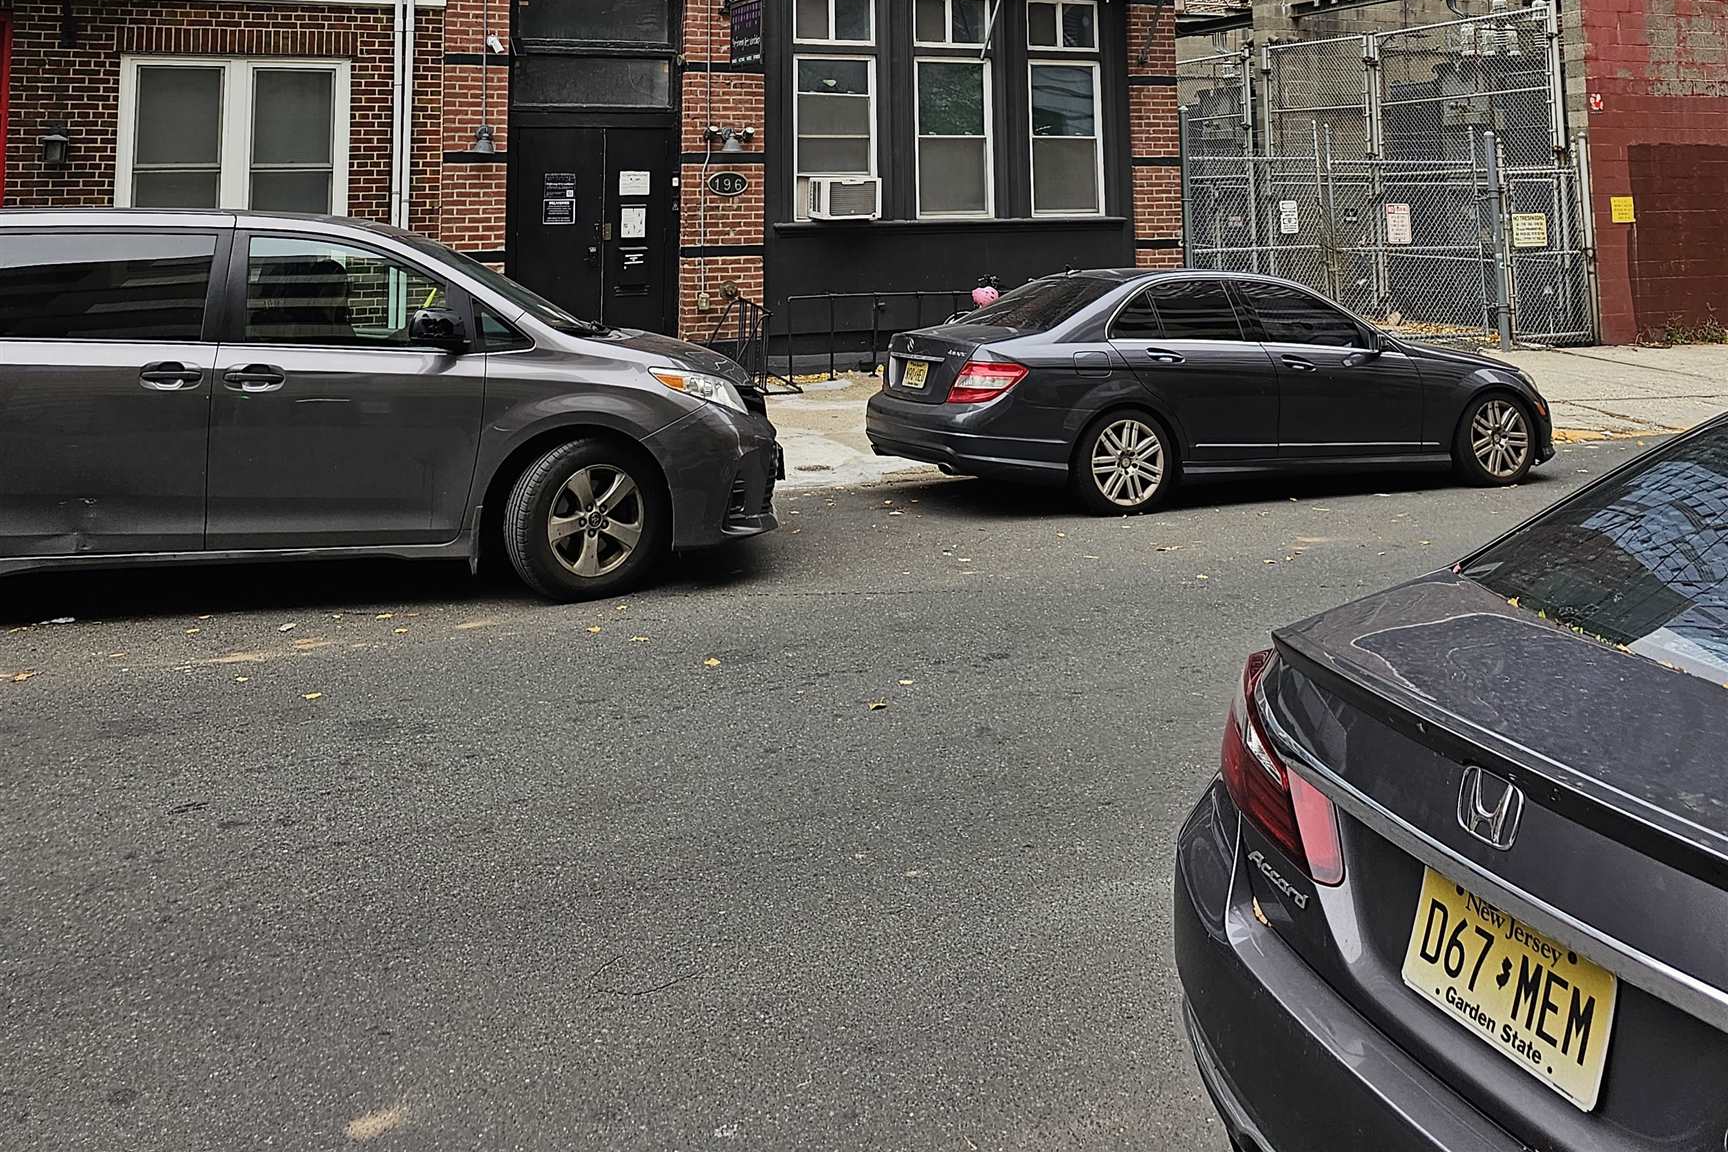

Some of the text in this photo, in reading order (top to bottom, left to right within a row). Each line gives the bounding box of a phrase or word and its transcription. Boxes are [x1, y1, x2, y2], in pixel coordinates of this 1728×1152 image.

[714, 177, 743, 191] 196
[1247, 850, 1309, 909] Accord
[1464, 893, 1563, 968] New Jersey
[1419, 898, 1596, 1067] D67 MEM
[1445, 986, 1542, 1065] Garden State
